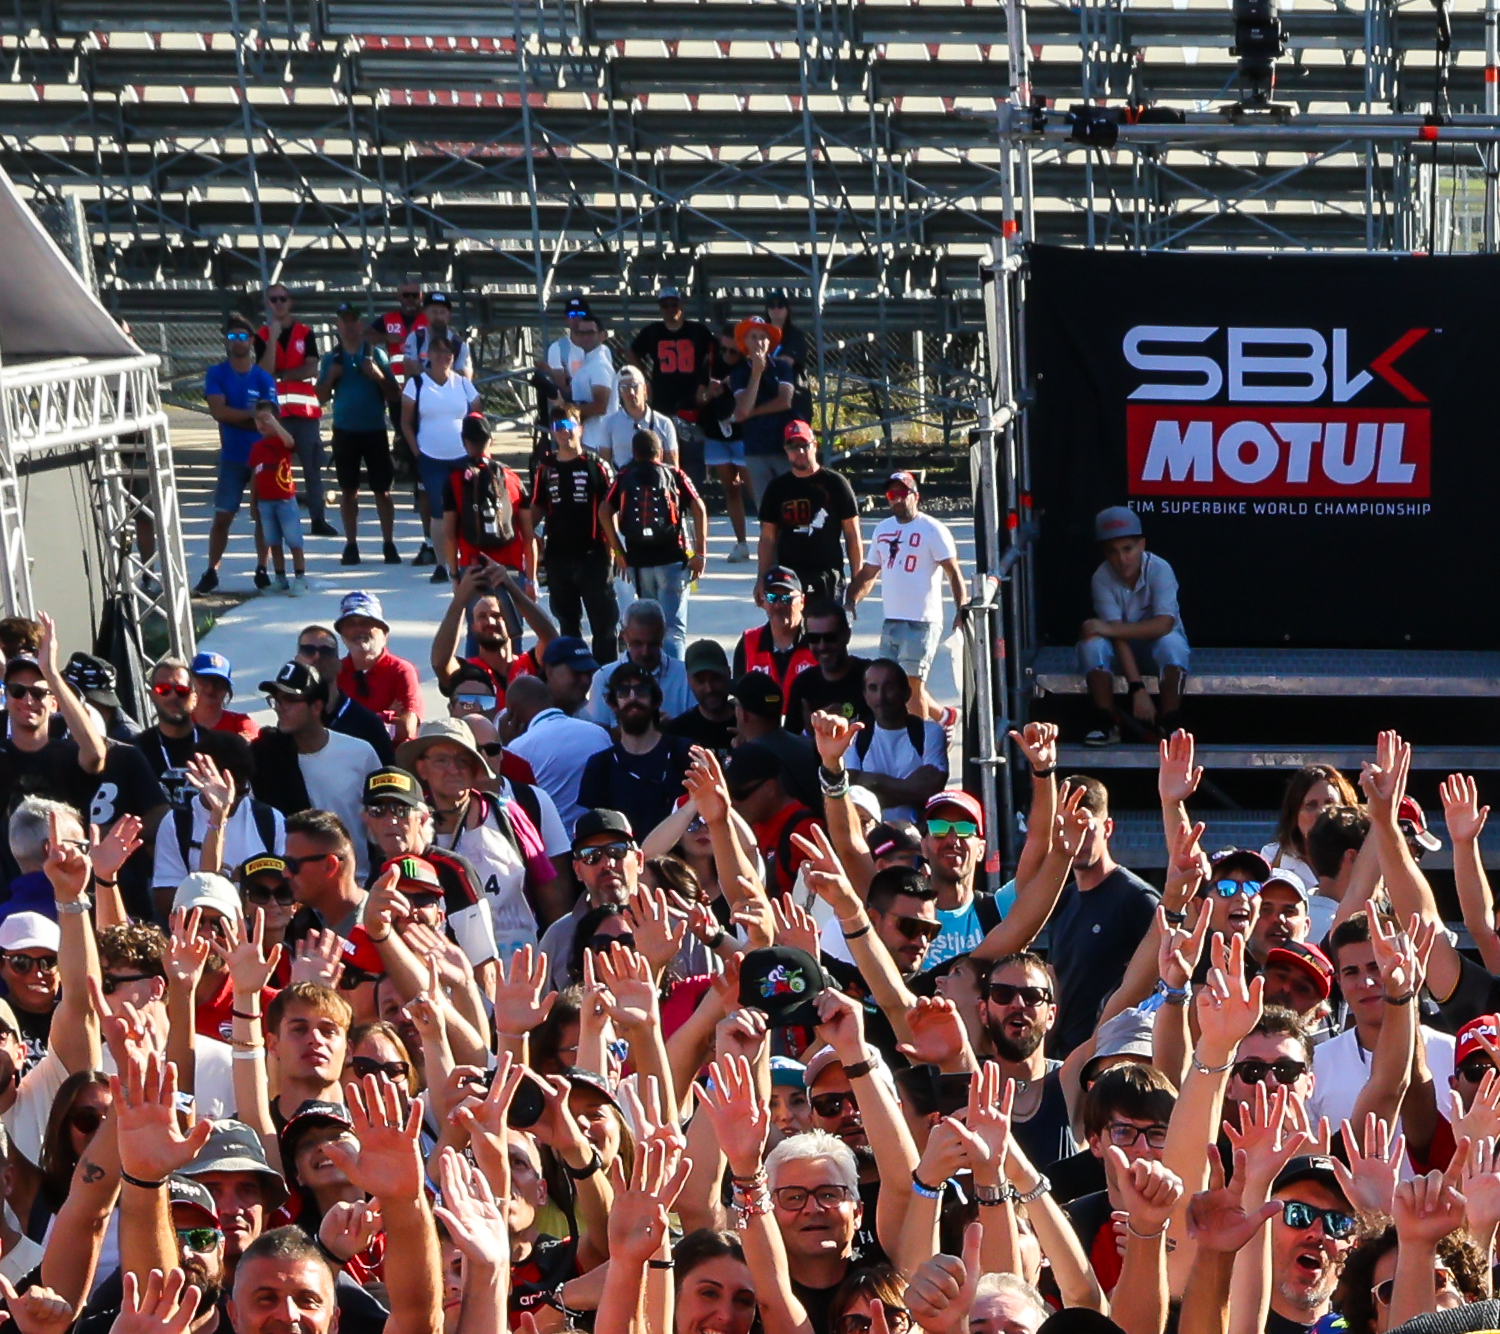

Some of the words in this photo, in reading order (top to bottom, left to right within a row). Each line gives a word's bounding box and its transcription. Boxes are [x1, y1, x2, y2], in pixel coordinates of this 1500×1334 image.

[657, 339, 695, 373] 58
[1122, 325, 1430, 403] SBK
[1141, 420, 1417, 485] MOTUL
[1160, 501, 1246, 515] SUPERBIKE
[1252, 502, 1308, 516] WORLD
[1314, 502, 1431, 517] CHAMPIONSHIP
